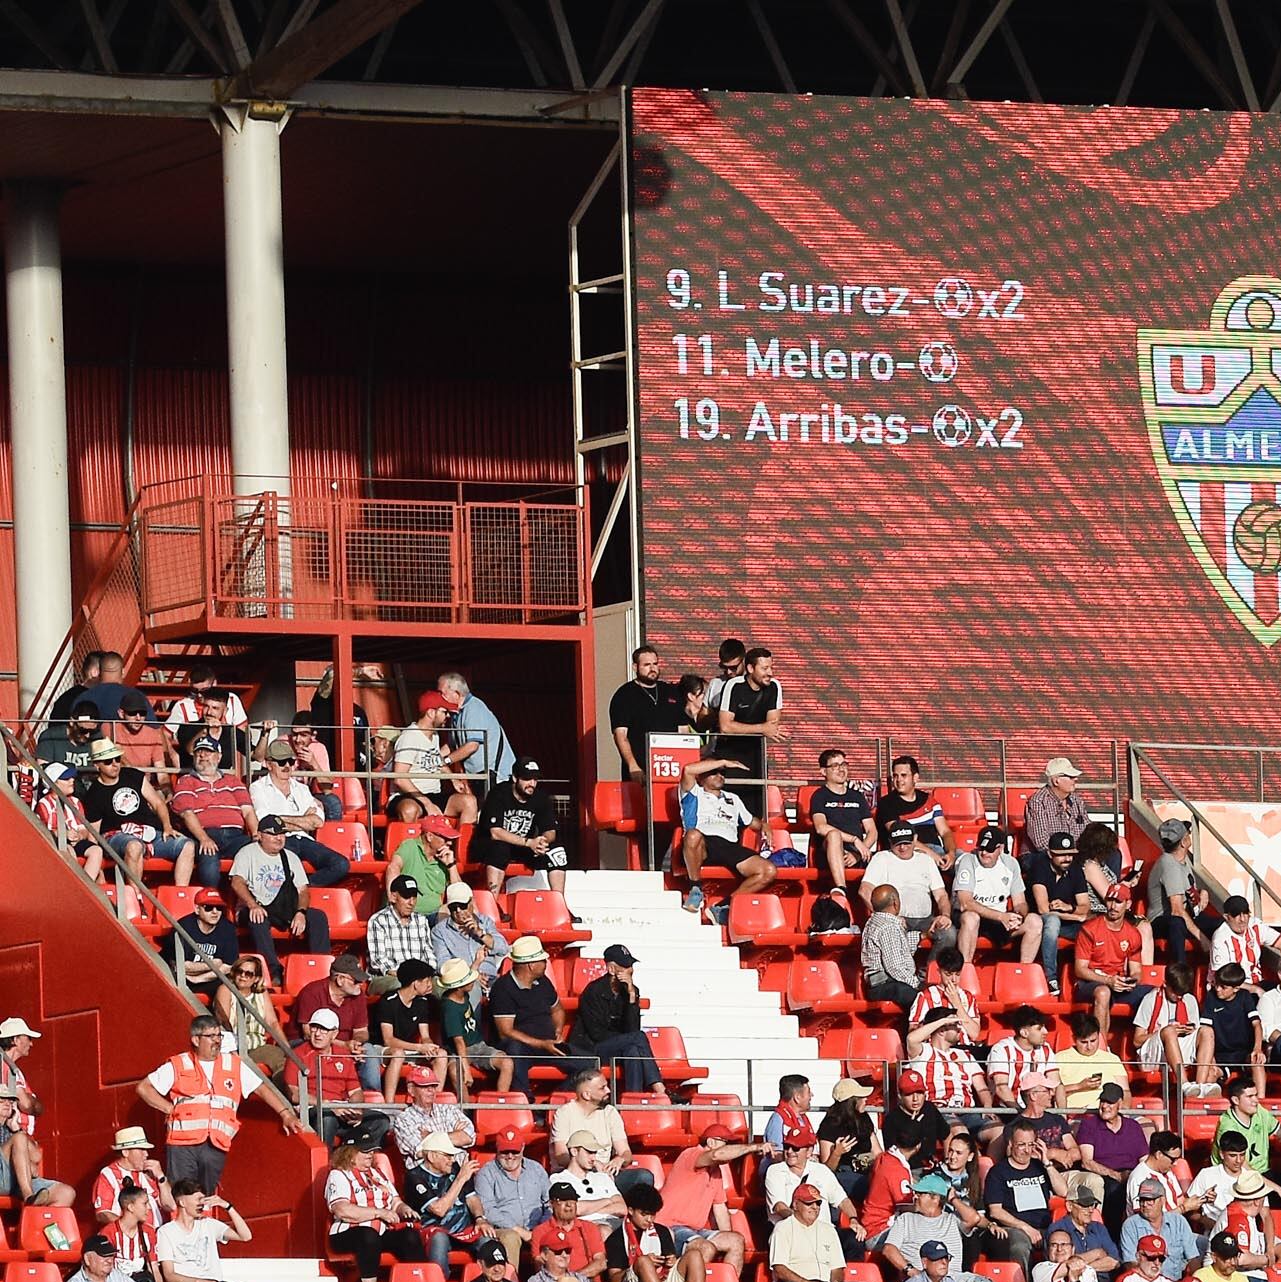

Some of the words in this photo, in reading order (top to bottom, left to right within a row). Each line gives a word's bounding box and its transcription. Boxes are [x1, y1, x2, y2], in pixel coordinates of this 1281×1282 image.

[665, 268, 702, 310] 9.
[672, 333, 729, 376] 11.
[1170, 355, 1216, 395] U
[674, 398, 731, 440] 19.
[653, 754, 673, 762] Sector
[653, 762, 680, 777] 135
